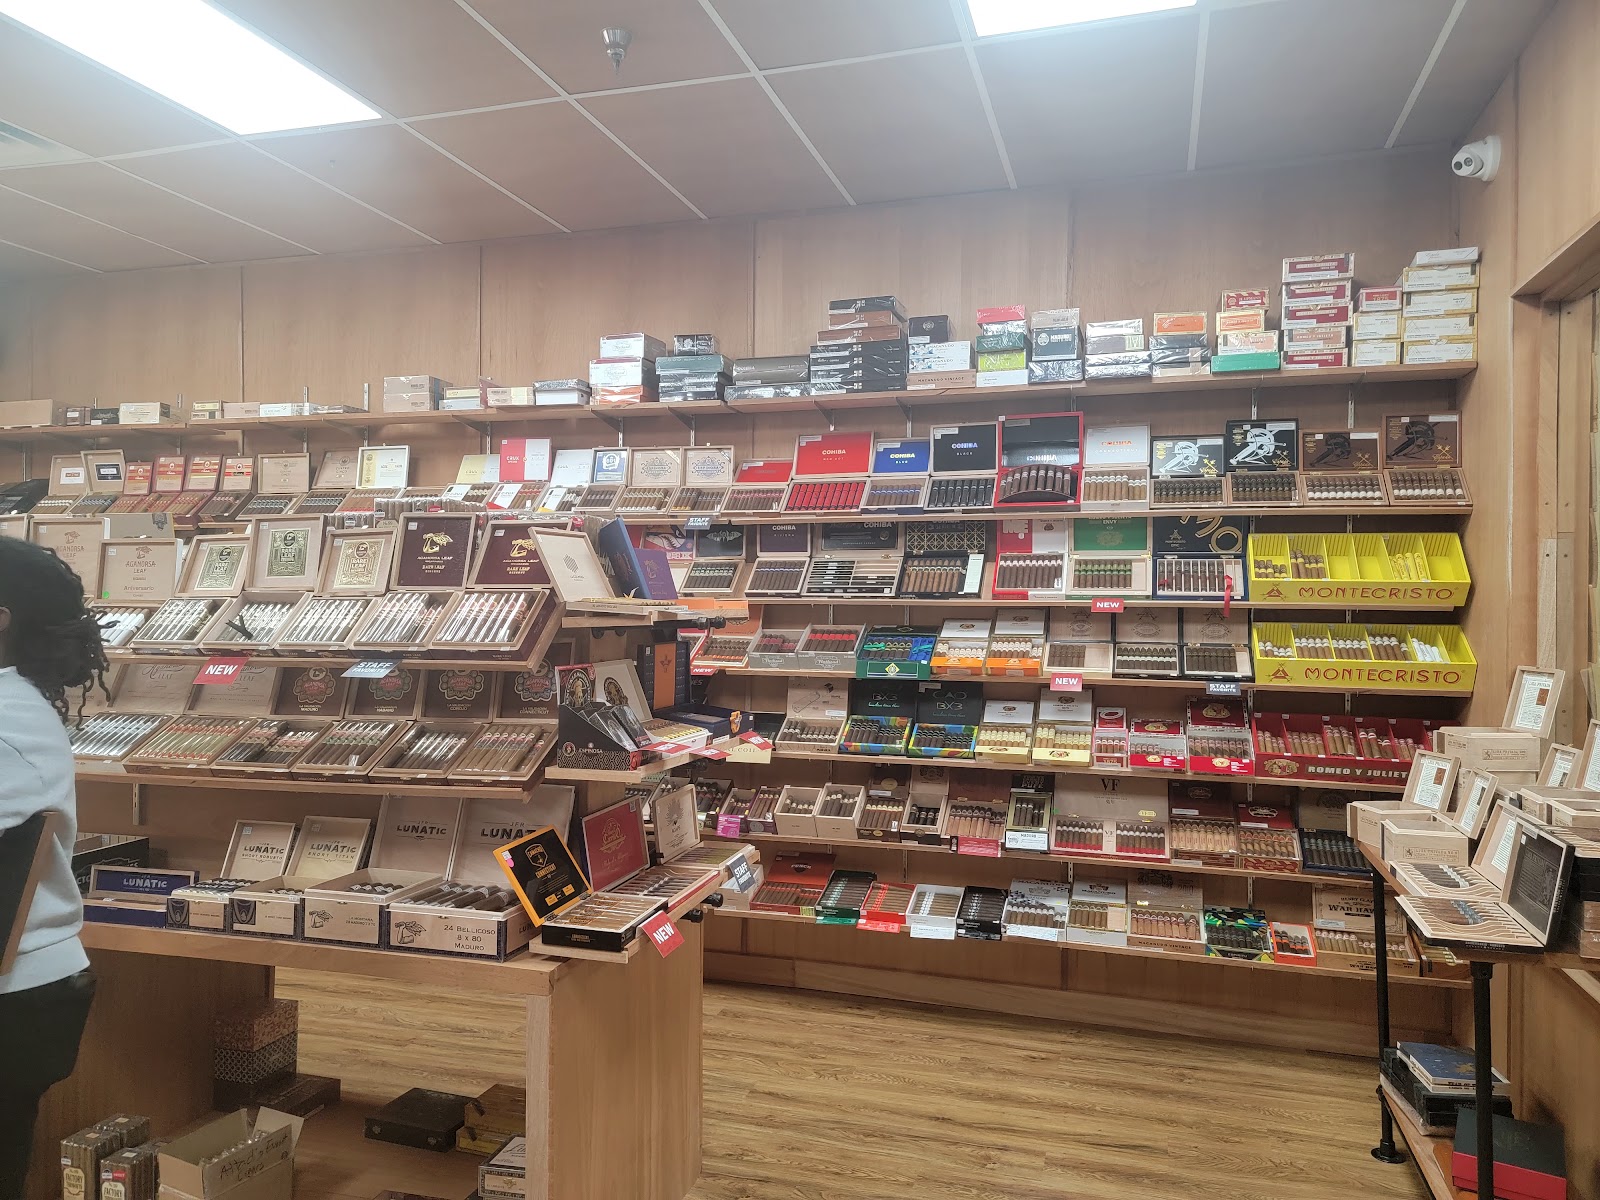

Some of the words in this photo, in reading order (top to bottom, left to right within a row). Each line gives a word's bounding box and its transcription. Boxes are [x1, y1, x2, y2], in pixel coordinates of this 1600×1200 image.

[1298, 586, 1453, 600] MONTECRISTO
[204, 665, 238, 675] NEW
[358, 661, 393, 669] STAFF
[1304, 667, 1462, 684] MONTECRISTO
[933, 691, 967, 700] CAO
[937, 701, 962, 710] BX3
[1308, 766, 1350, 774] ROMEO
[1367, 770, 1408, 778] JULIET
[1101, 778, 1120, 791] VF
[396, 824, 447, 835] LUNATIC
[480, 827, 537, 840] LUNAT
[244, 846, 284, 854] LUNATIC
[311, 843, 357, 853] LUNATIC
[734, 862, 748, 878] STAFF
[123, 878, 167, 888] LUNATIC
[653, 922, 675, 944] NEW
[454, 942, 485, 951] MADURO
